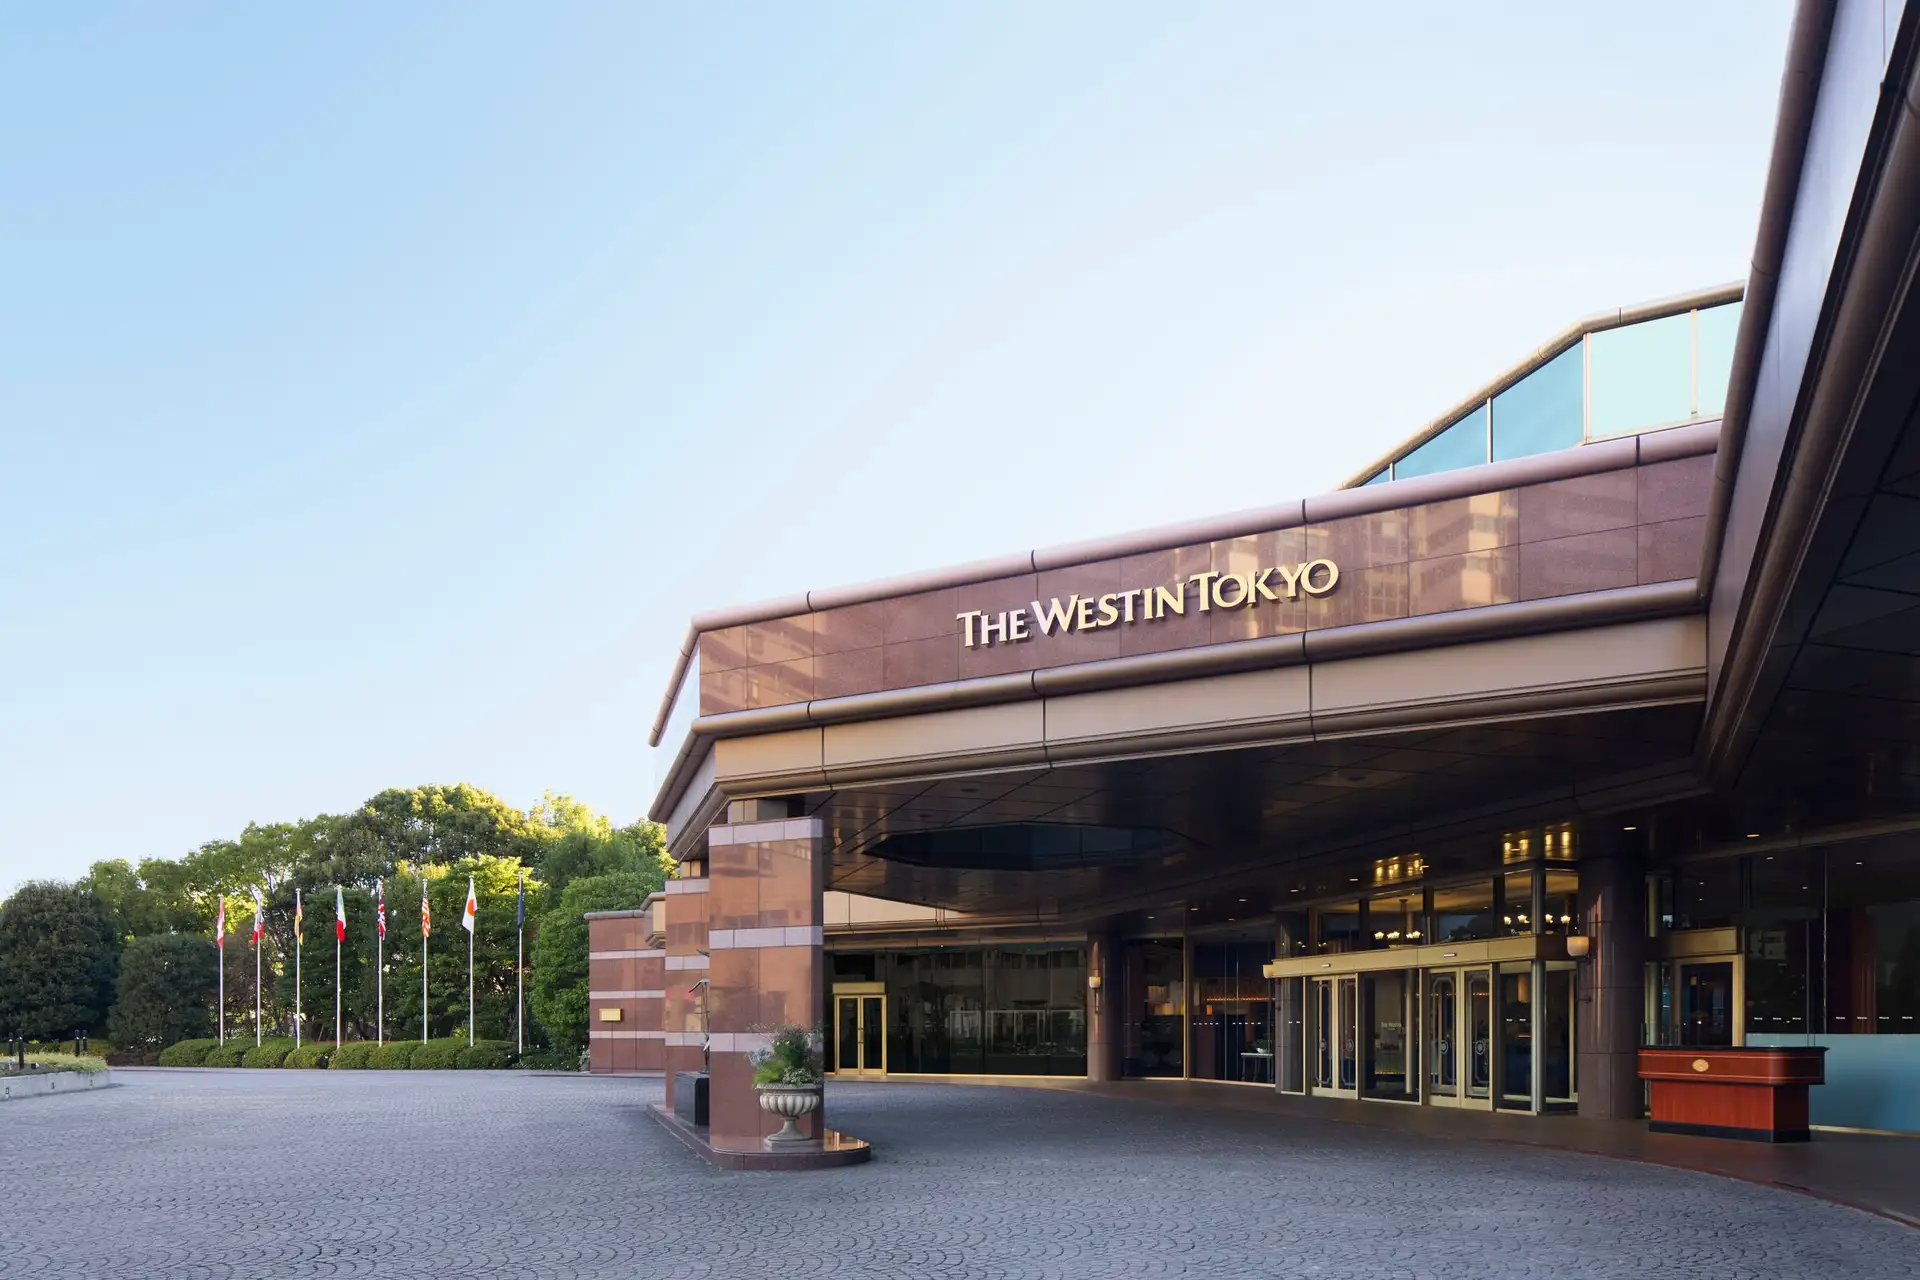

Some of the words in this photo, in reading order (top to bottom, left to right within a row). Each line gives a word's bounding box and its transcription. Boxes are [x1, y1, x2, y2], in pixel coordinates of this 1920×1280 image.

[956, 609, 1029, 647] THE
[1030, 582, 1186, 636] WESTIN
[1189, 559, 1340, 612] TOKYO
